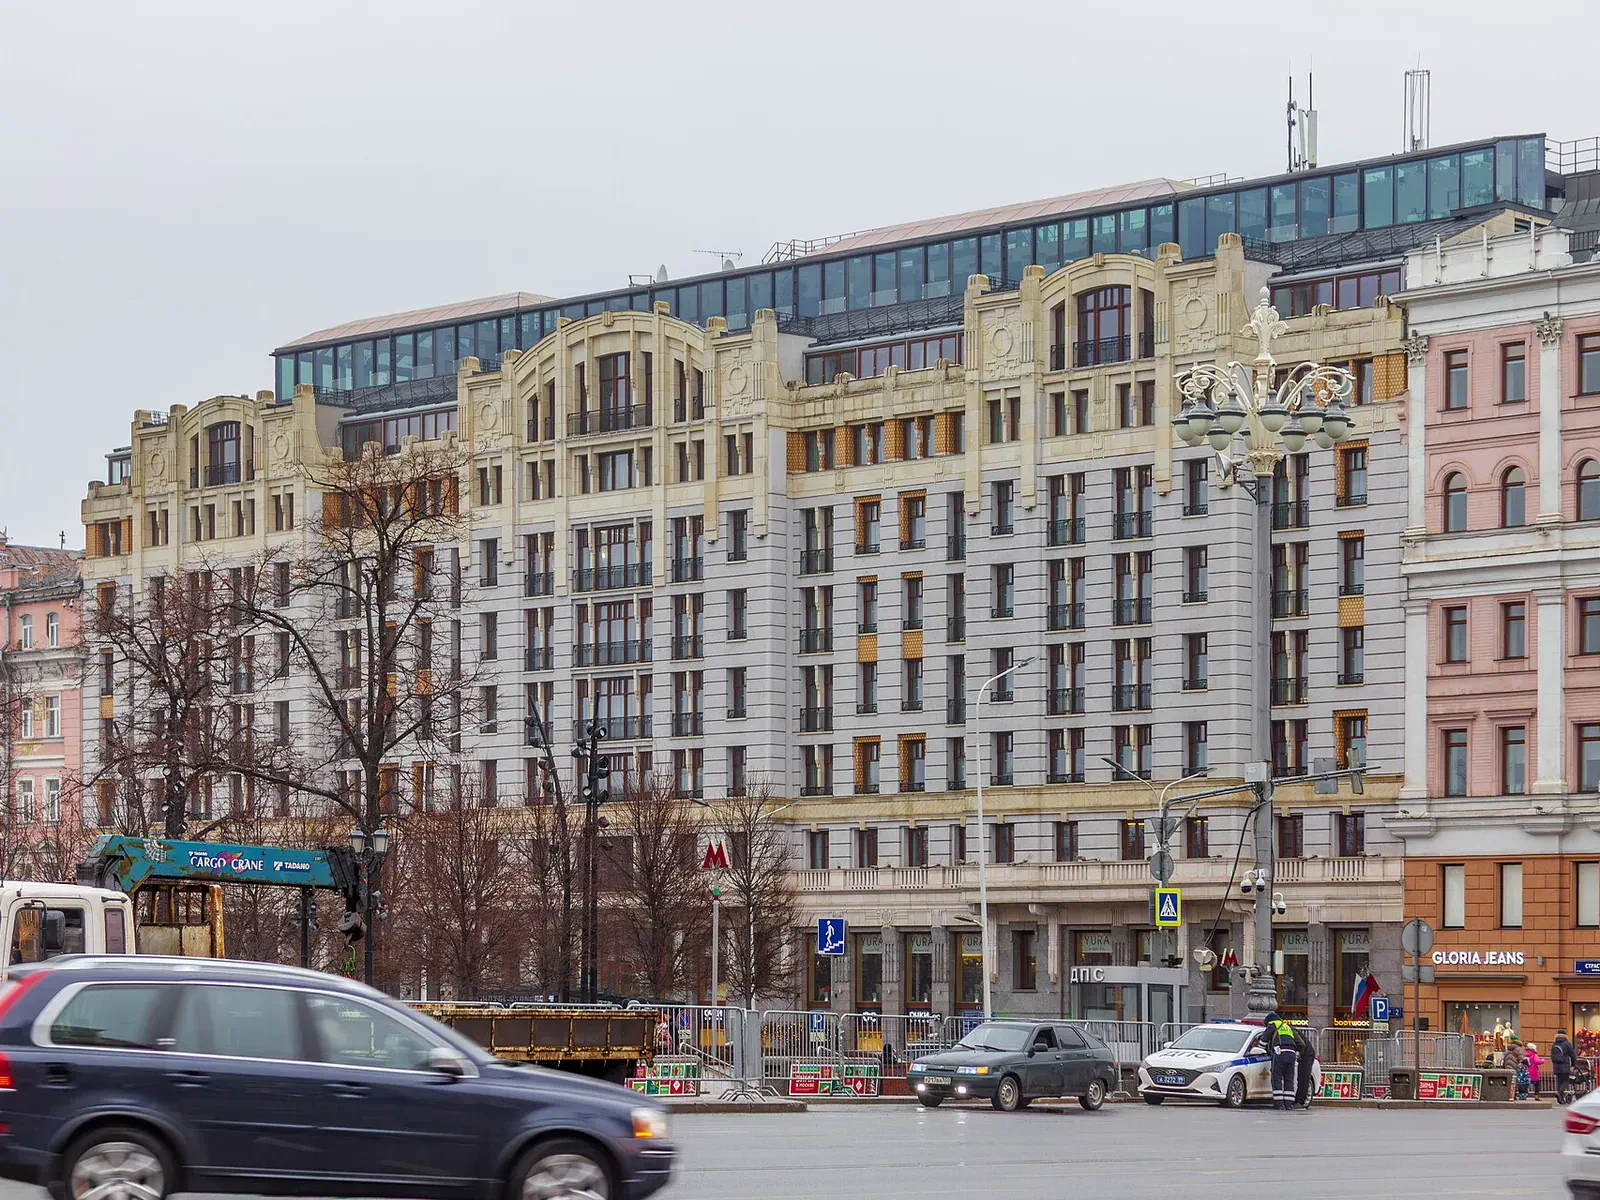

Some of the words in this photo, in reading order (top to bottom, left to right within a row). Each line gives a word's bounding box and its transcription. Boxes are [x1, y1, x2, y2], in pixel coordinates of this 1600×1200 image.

[701, 839, 730, 870] М
[190, 856, 226, 869] CARGO
[231, 858, 264, 871] CRANE
[284, 861, 310, 870] TADANO
[1084, 935, 1110, 946] YURA
[1281, 934, 1309, 945] YURA
[1340, 934, 1370, 945] YURA
[1431, 951, 1482, 965] GLORIA
[1483, 951, 1525, 965] JEANS
[1070, 967, 1105, 983] ДПС
[1376, 1000, 1387, 1018] P
[1160, 1050, 1212, 1059] ДПС
